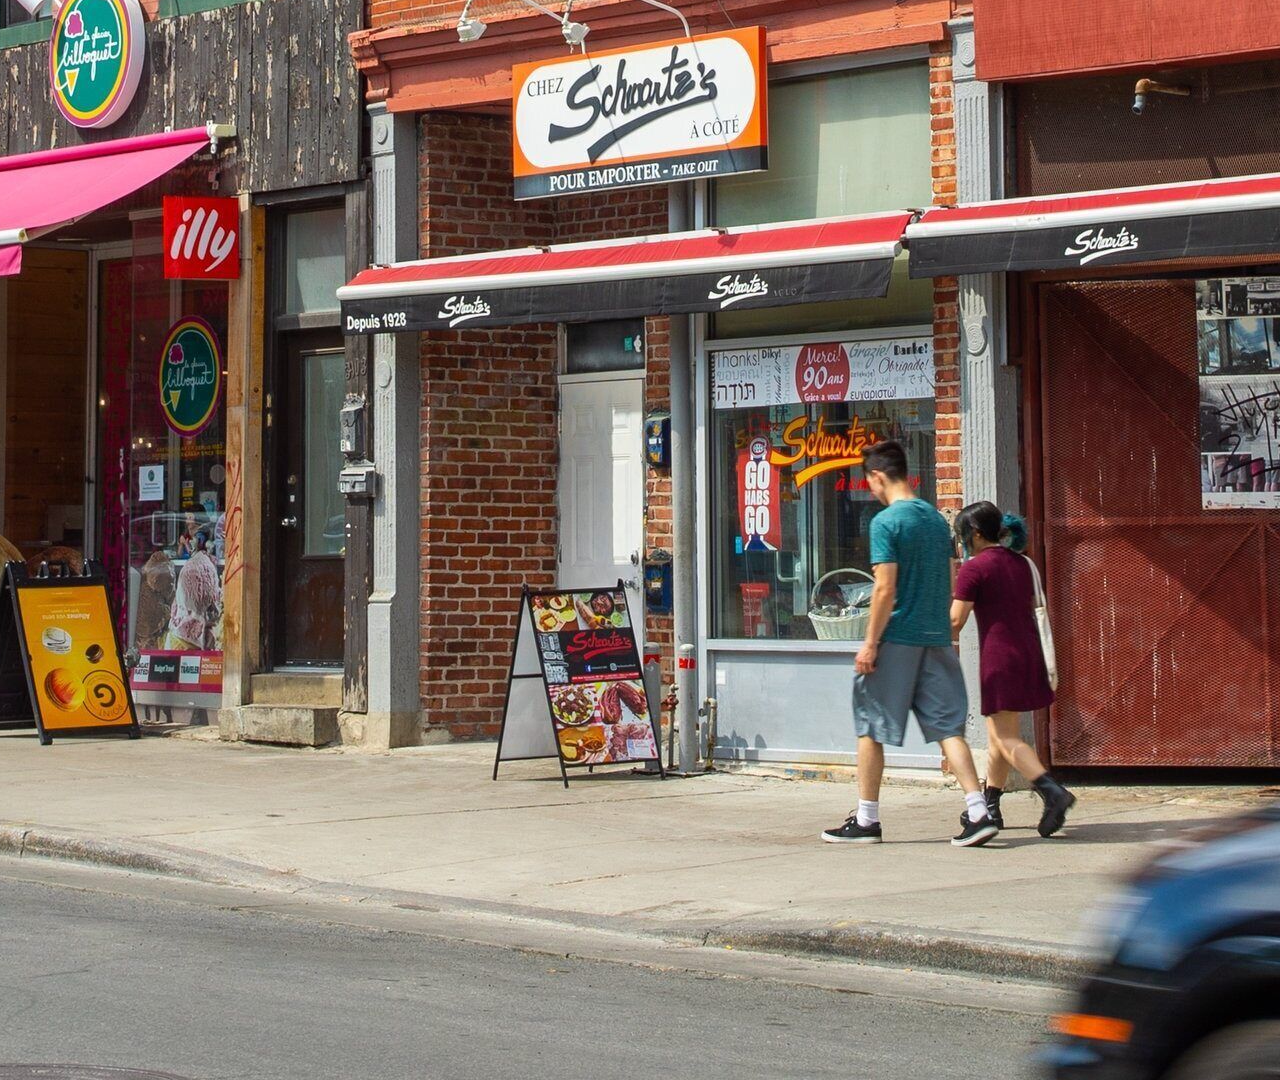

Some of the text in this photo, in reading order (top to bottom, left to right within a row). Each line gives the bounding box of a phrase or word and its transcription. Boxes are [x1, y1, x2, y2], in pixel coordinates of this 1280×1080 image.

[526, 77, 564, 97] CHEZ
[548, 45, 718, 163] Schwartz's
[690, 116, 740, 139] À CÔTÉ
[549, 159, 719, 192] POUR EMPORTER TAKE OUT
[170, 207, 237, 274] illy
[346, 312, 407, 332] Depuis 1928
[803, 344, 842, 366] Merci!
[849, 341, 893, 369] Grazie!
[893, 342, 929, 356] Danke!
[878, 357, 930, 376] Obrigado!
[802, 366, 844, 391] 90 ans
[804, 391, 820, 402] Grâce
[744, 461, 770, 490] GO
[744, 489, 770, 506] HABS
[744, 505, 770, 536] GO
